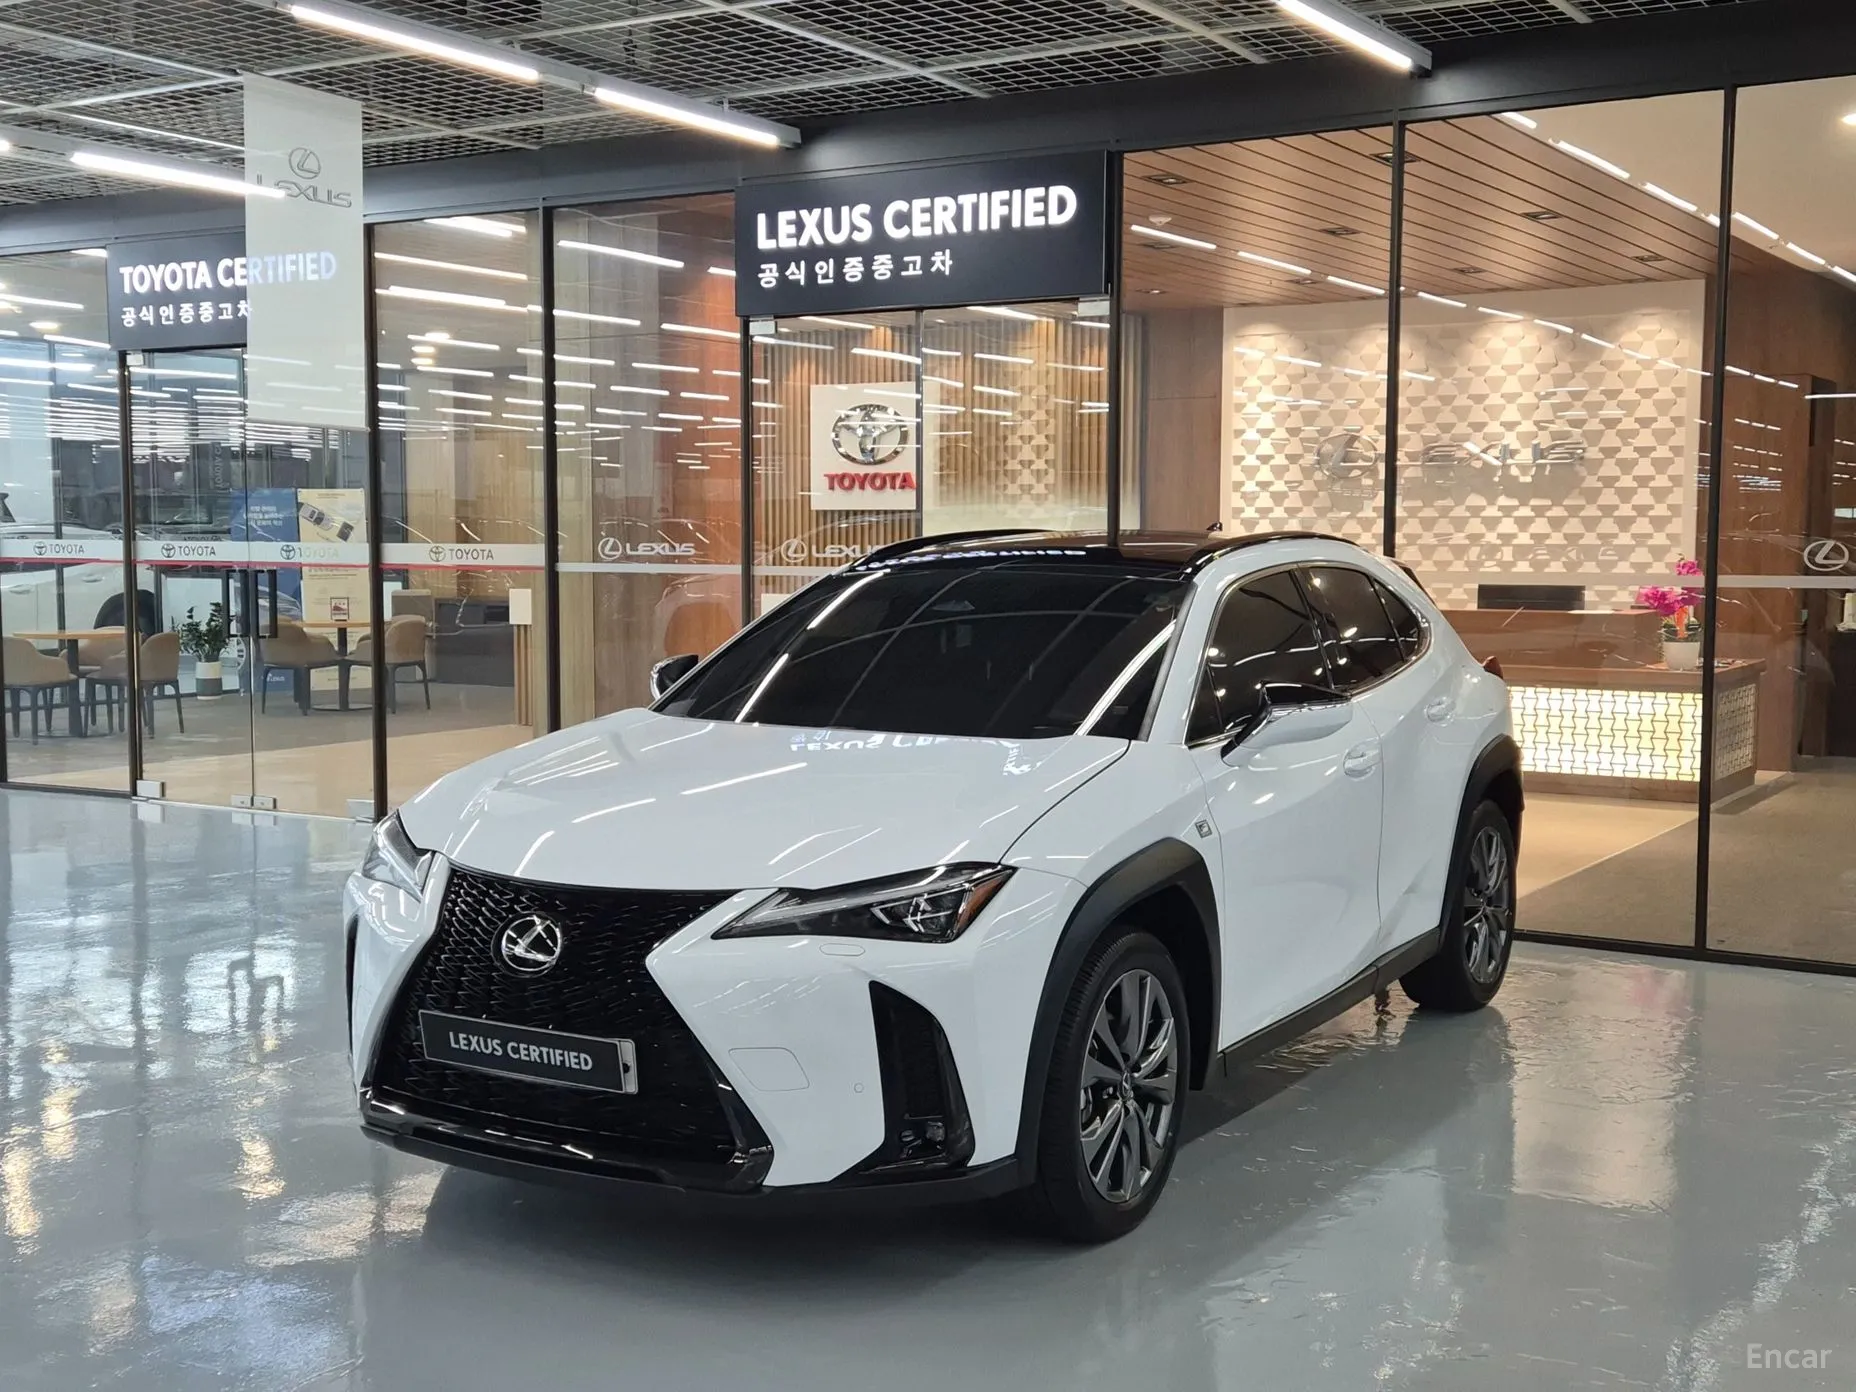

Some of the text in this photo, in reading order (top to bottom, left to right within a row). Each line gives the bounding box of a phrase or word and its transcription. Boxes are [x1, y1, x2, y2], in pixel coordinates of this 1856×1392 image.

[756, 184, 1077, 251] LEXUS CERTIFIED
[119, 251, 337, 293] TOYOTA CERTIFIED
[757, 249, 953, 288] 공식인증중고차
[121, 300, 253, 328] 공식인증중고차
[824, 471, 916, 491] TOYOTA
[48, 544, 85, 554] TOYOTA
[178, 545, 216, 557] TOYOTA
[449, 548, 494, 561] TOYOTA
[626, 543, 696, 555] LEXUS
[812, 545, 887, 558] LEXU
[449, 1031, 593, 1071] LEXUS CERTIFIED
